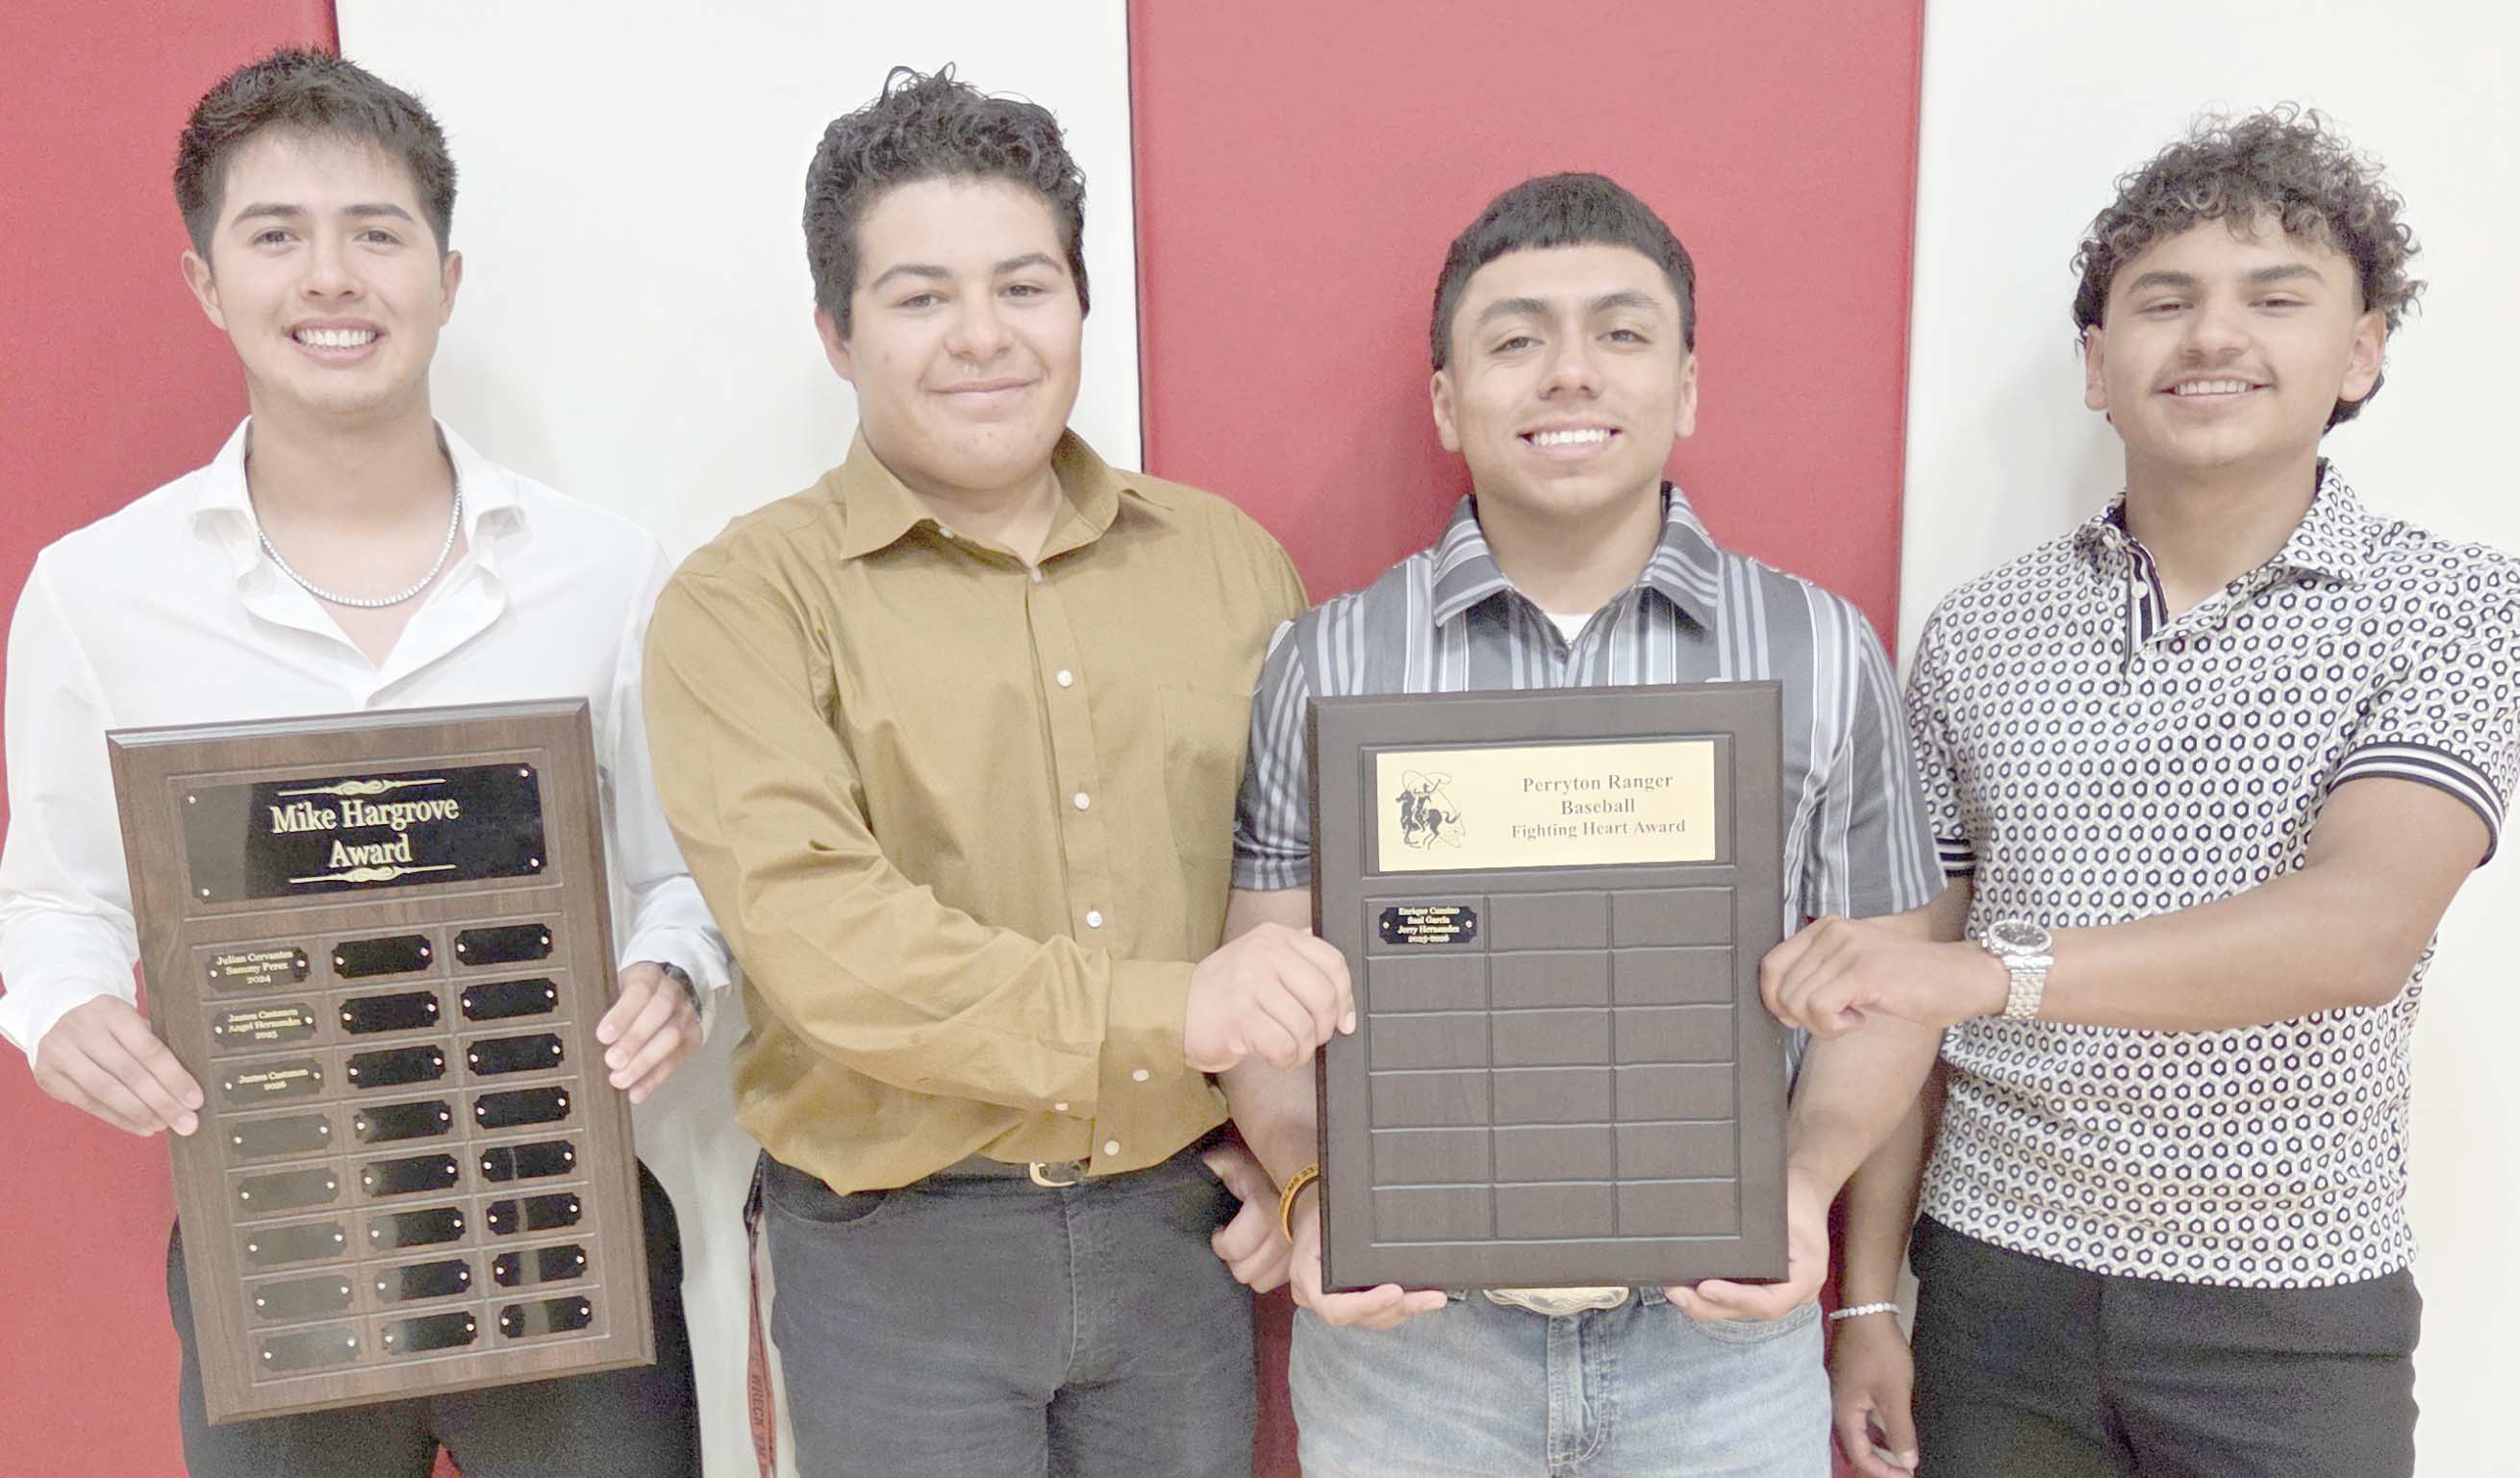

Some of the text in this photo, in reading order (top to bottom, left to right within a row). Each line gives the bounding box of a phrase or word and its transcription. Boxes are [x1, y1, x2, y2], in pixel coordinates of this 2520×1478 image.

[1523, 773, 1674, 795] Perryton Ranger
[270, 796, 461, 835] Mike Hargrove
[1560, 798, 1635, 815] Baseball
[1511, 818, 1686, 841] Fighting Heart Award
[327, 833, 414, 869] Award
[215, 954, 247, 966] Julian
[225, 962, 290, 976] Sammy Perez
